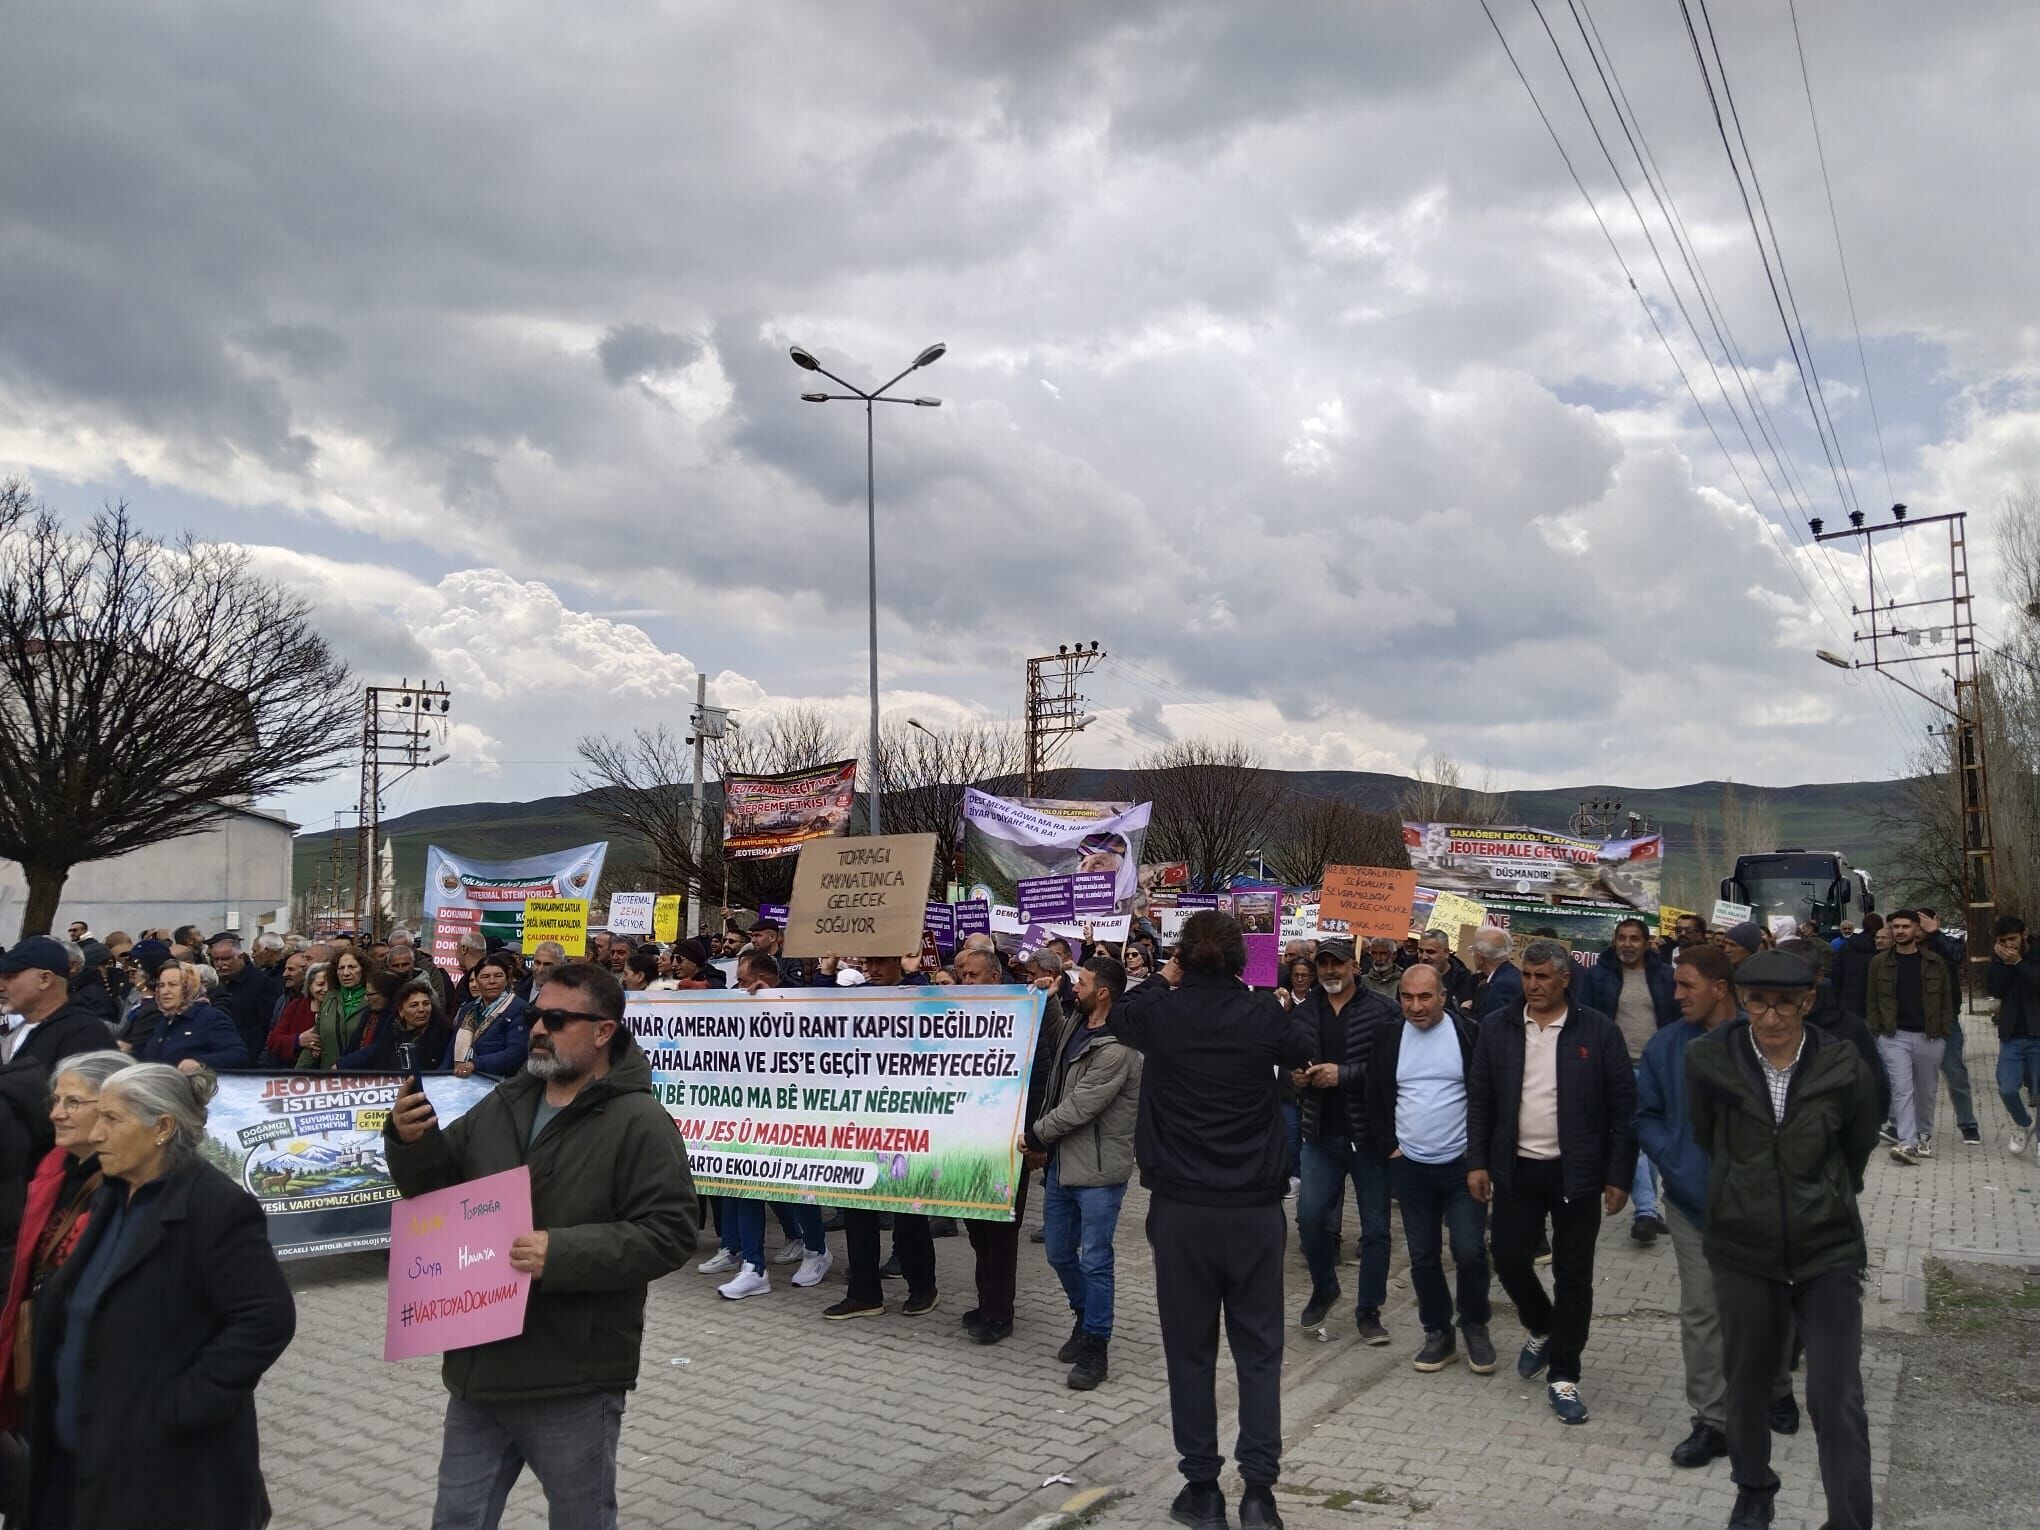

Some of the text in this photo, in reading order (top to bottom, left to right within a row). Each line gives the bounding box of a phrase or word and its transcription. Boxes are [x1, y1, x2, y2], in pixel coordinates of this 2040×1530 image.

[738, 802, 786, 814] DEPREME
[1449, 829, 1501, 839] SAKAÖREN
[1448, 841, 1532, 858] JEOTERMALE
[1534, 845, 1569, 861] GEÇİT
[1570, 848, 1599, 864] YOK
[820, 870, 905, 889] KAYNATINCA
[1496, 868, 1552, 880] DÜŞMANDIR!
[613, 895, 651, 905] JEOTERMAL
[827, 892, 887, 909] GELECEK
[440, 909, 473, 920] DOKUNMA
[561, 933, 580, 942] KÖYÜ
[668, 1014, 746, 1040] (AMERAN)
[751, 1011, 795, 1038] KÖYÜ
[799, 1015, 848, 1038] RANT
[853, 1015, 914, 1038] KAPISI
[919, 1010, 1015, 1039] DEĞİLDİR!
[745, 1051, 767, 1073] VE
[820, 1047, 872, 1079] GEÇİT
[876, 1048, 1019, 1077] VERMEYECEĞİZ.
[667, 1079, 686, 1105] BÊ
[690, 1084, 744, 1108] TORAQ
[747, 1086, 772, 1109] MA
[777, 1082, 798, 1110] BÊ
[802, 1087, 863, 1112] WELAT
[300, 1112, 346, 1125] SUYUMUZU
[300, 1120, 349, 1133] KİRLETMEYİN!
[243, 1122, 287, 1138] DOĞAMIZI
[705, 1120, 738, 1143] JES
[738, 1117, 753, 1143] Û
[754, 1120, 827, 1149] MADENA
[831, 1122, 930, 1153] NÊWAZENA
[726, 1157, 782, 1180] EKOLOJİ
[783, 1163, 865, 1185] PLATFORMU
[350, 1191, 371, 1204] İÇİN
[373, 1191, 385, 1200] EL
[401, 1281, 519, 1328] #VARTOYADOKUNMA
